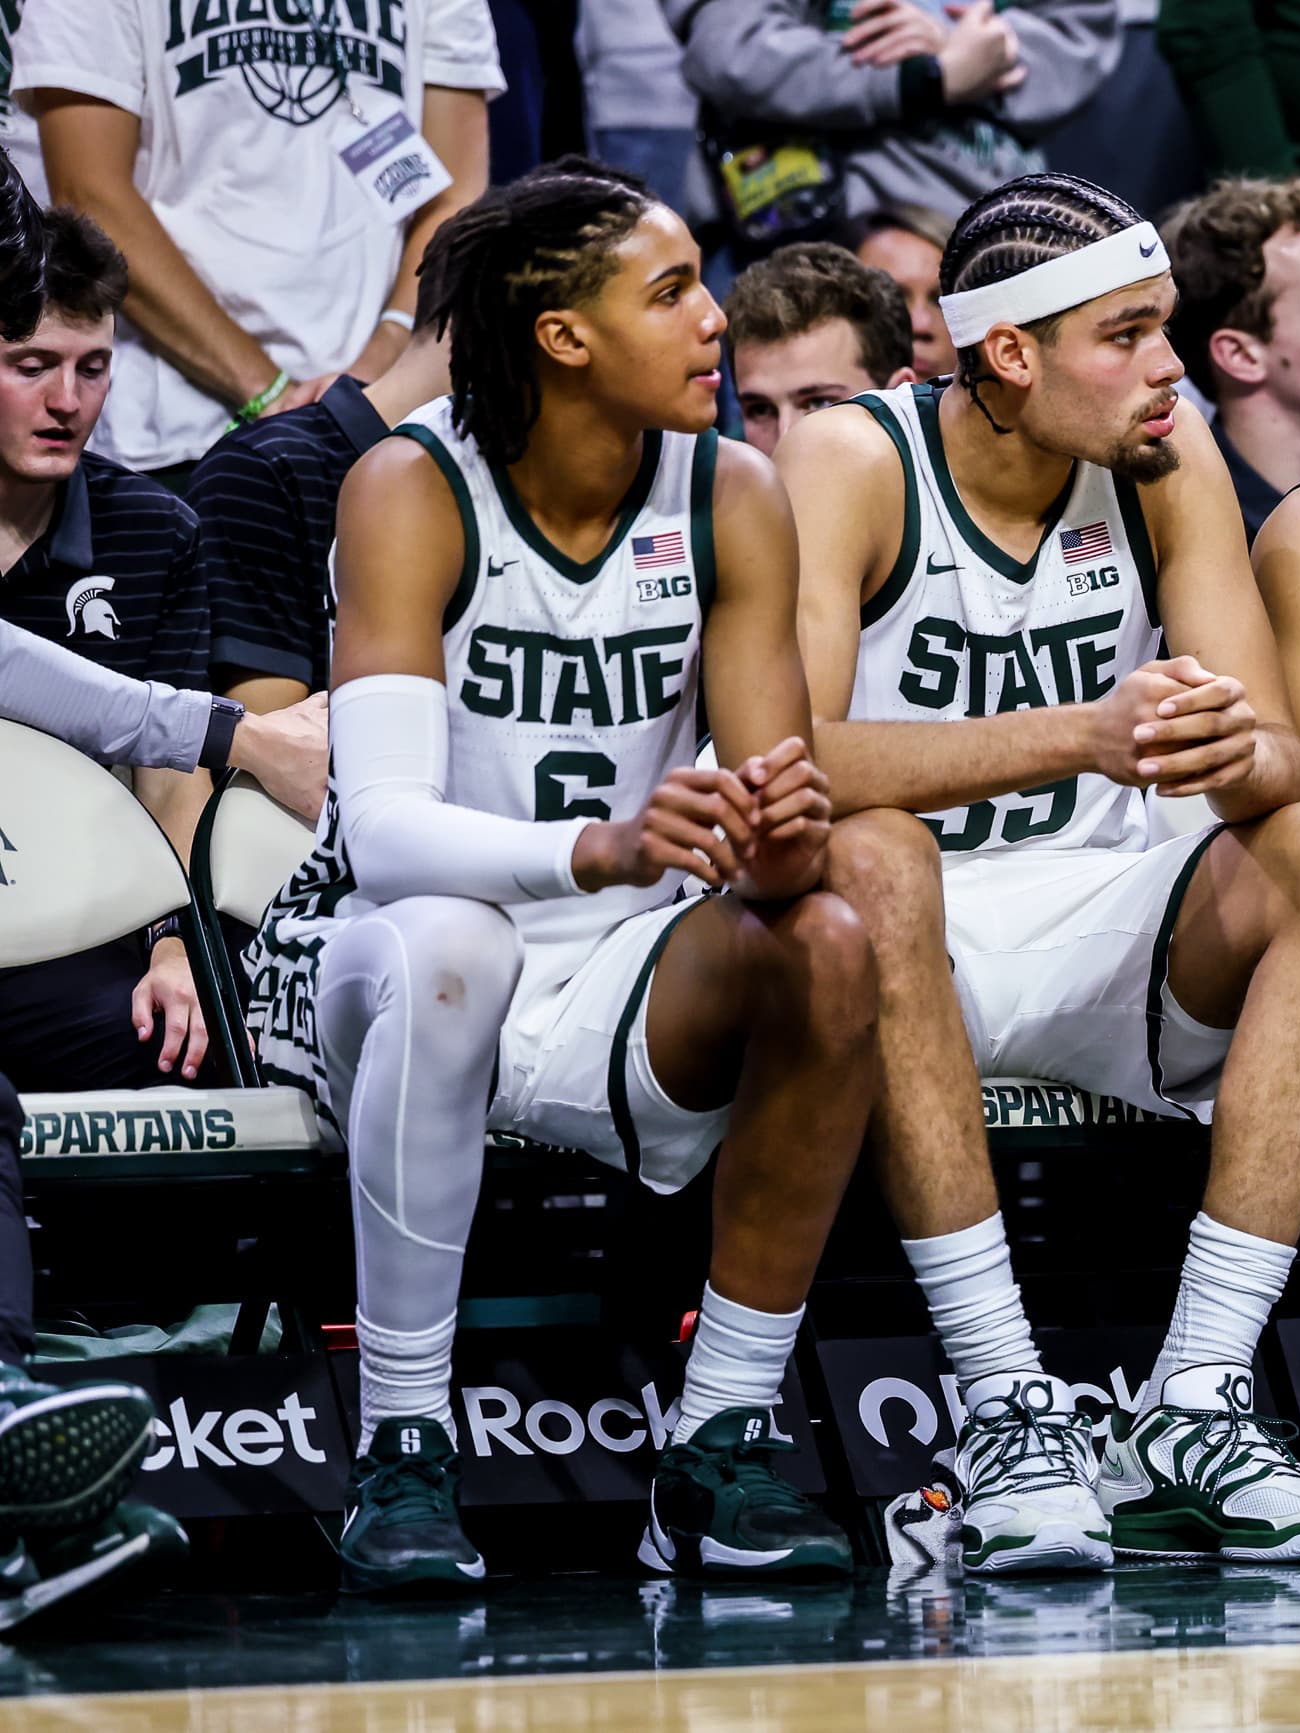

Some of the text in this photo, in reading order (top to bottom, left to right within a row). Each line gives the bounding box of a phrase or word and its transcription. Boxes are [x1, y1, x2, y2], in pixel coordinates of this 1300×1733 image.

[460, 622, 694, 727] STATE
[898, 608, 1125, 717] STATE
[982, 1084, 1190, 1127] SPARTAN
[140, 1391, 327, 1471] cket
[461, 1381, 794, 1457] Rock
